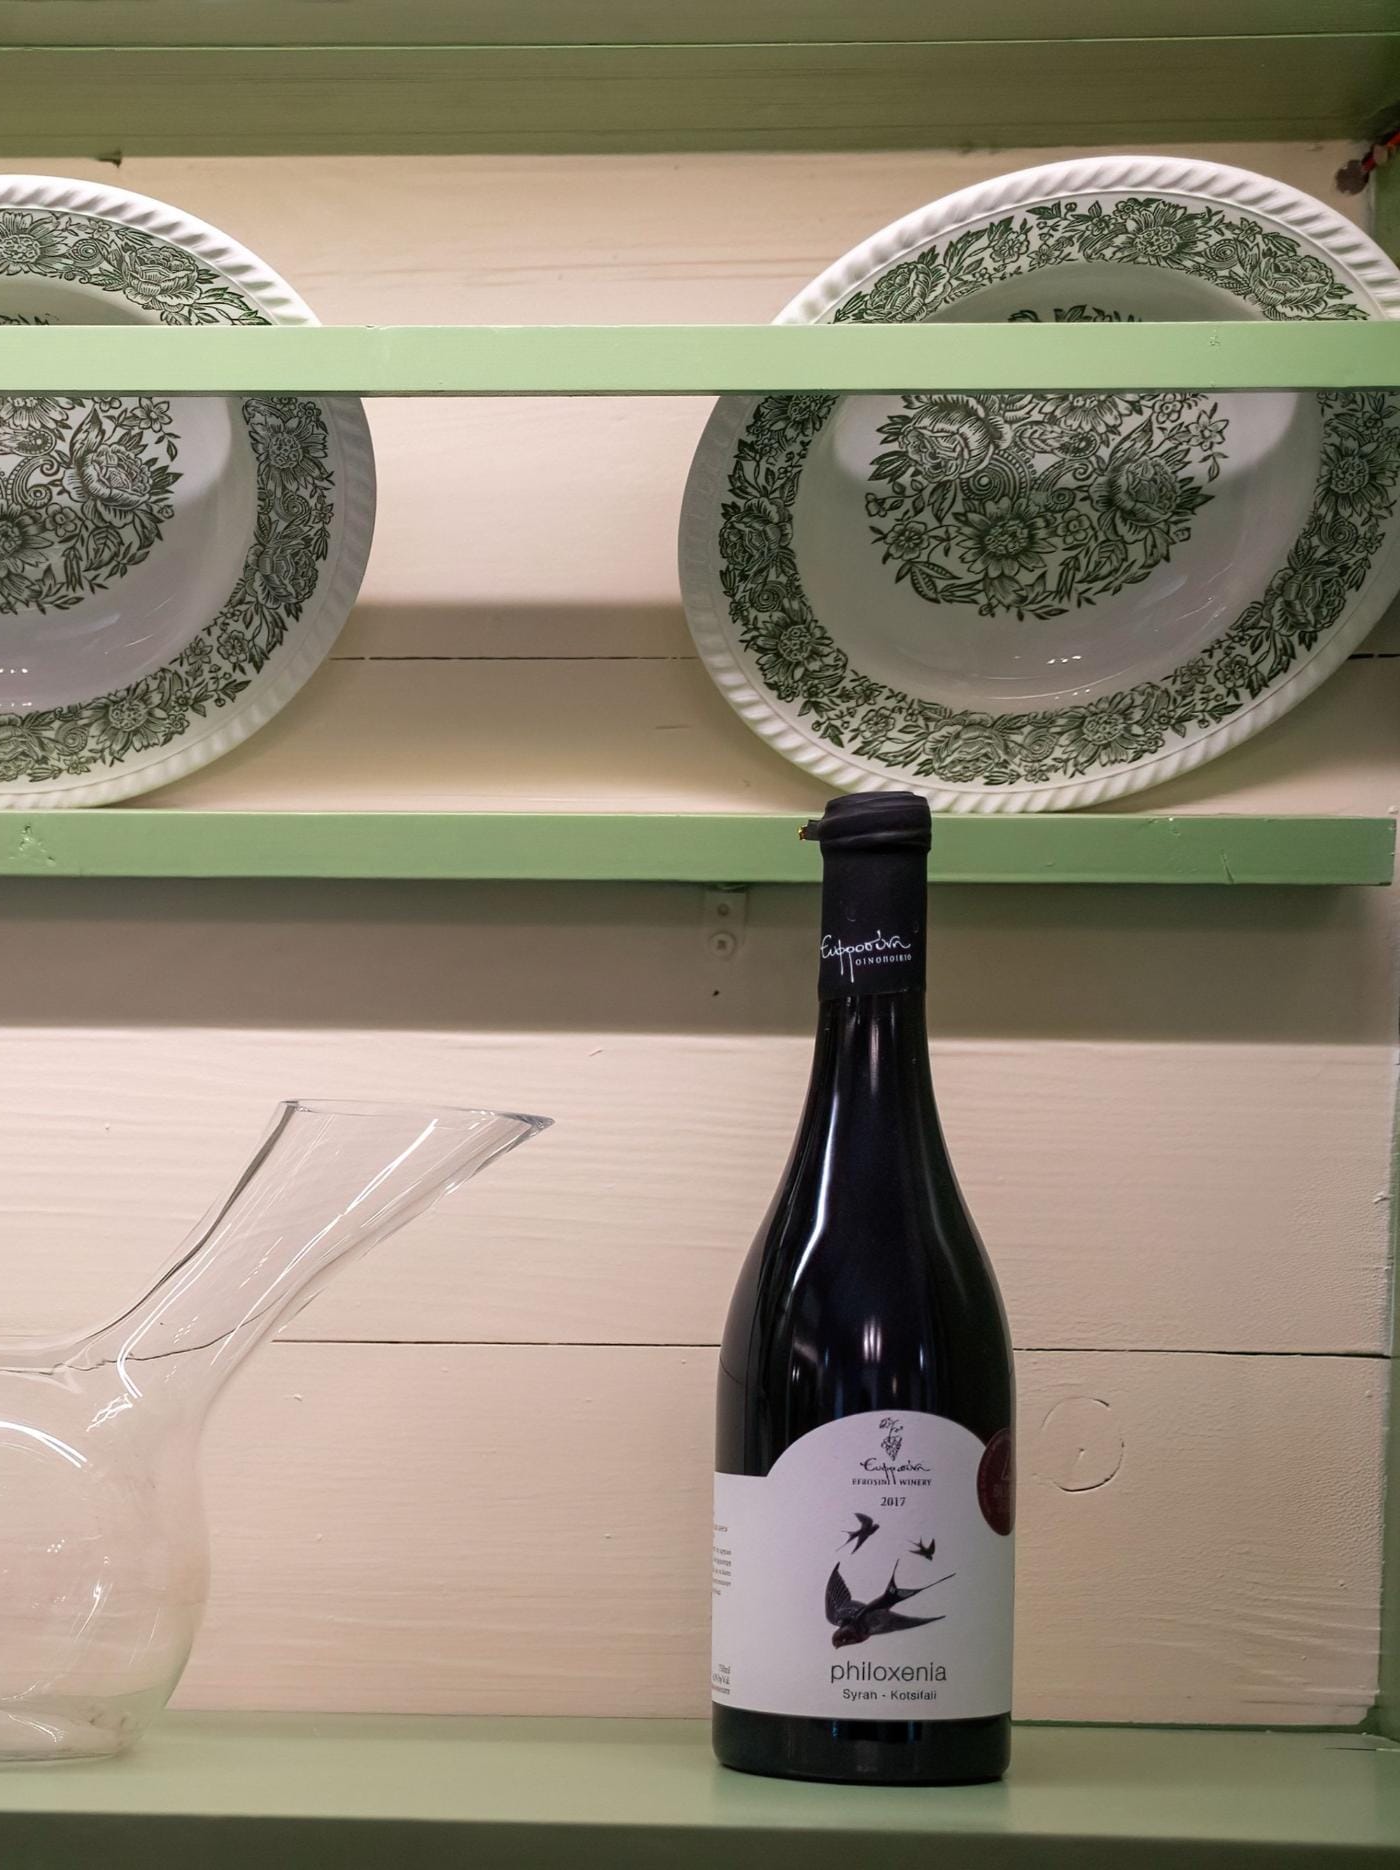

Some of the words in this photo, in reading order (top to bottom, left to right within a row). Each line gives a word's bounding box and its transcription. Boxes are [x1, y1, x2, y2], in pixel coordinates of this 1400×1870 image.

[899, 1478, 932, 1486] WINERY
[880, 1496, 906, 1507] 2017
[831, 1660, 947, 1684] philoxenia
[890, 1689, 937, 1701] Kotsifali
